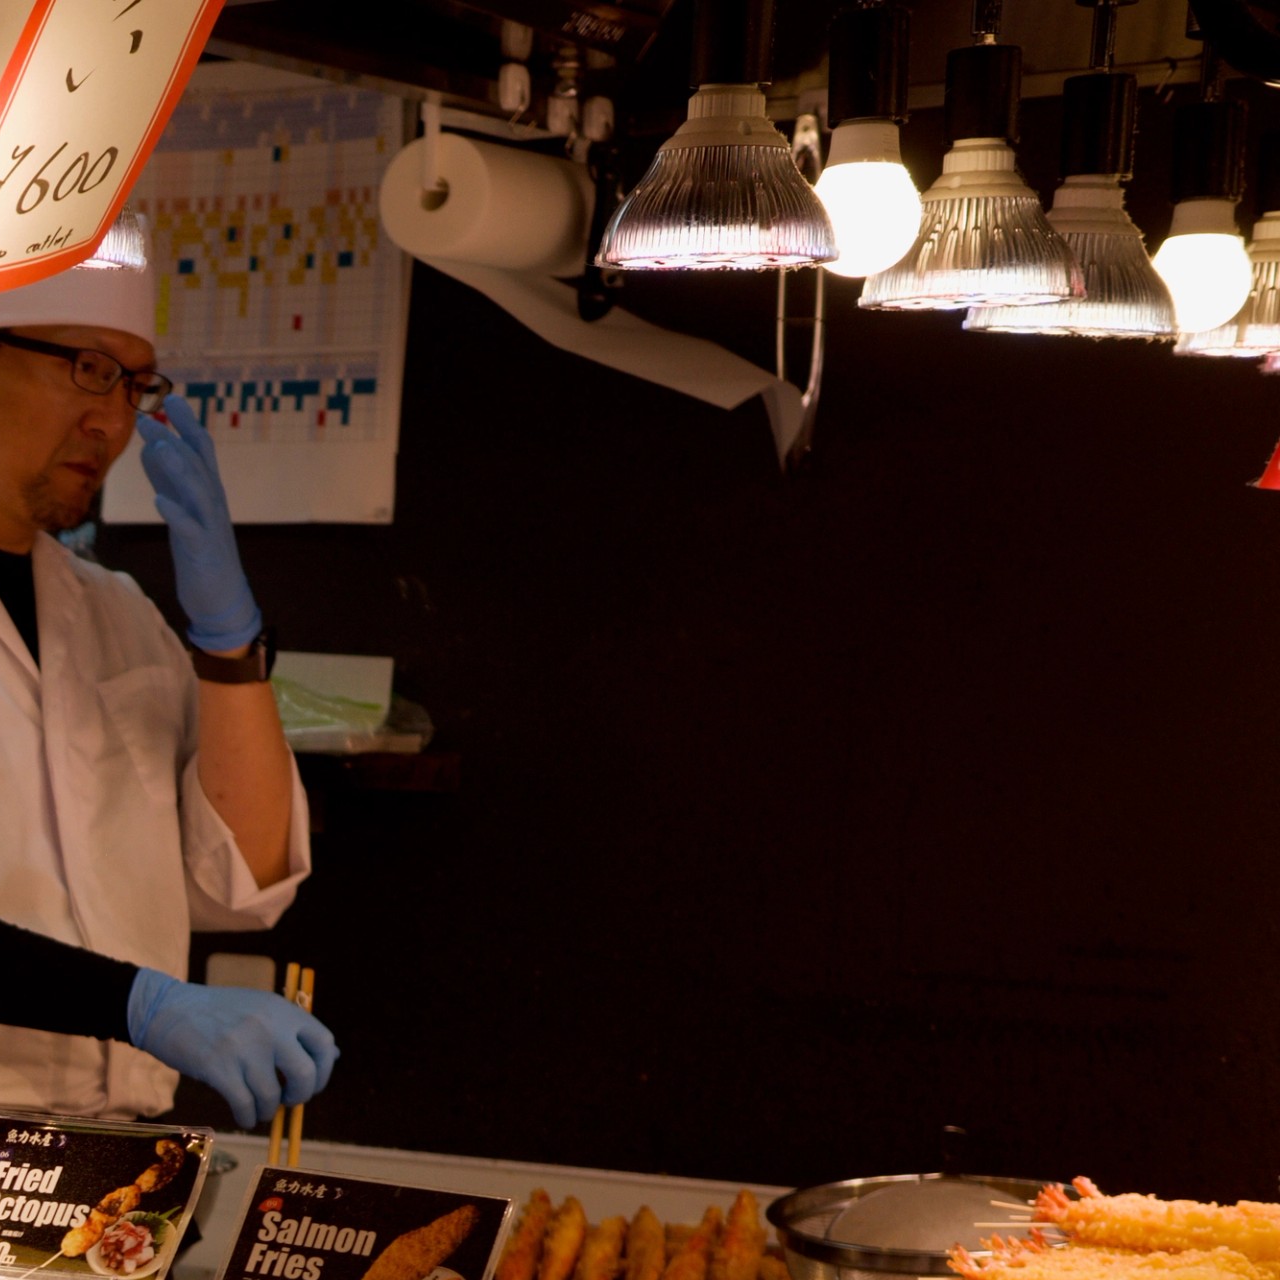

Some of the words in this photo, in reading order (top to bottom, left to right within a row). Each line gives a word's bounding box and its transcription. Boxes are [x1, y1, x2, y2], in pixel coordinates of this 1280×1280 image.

[272, 1178, 329, 1199] 魚力水産
[256, 1210, 378, 1258] Salmon
